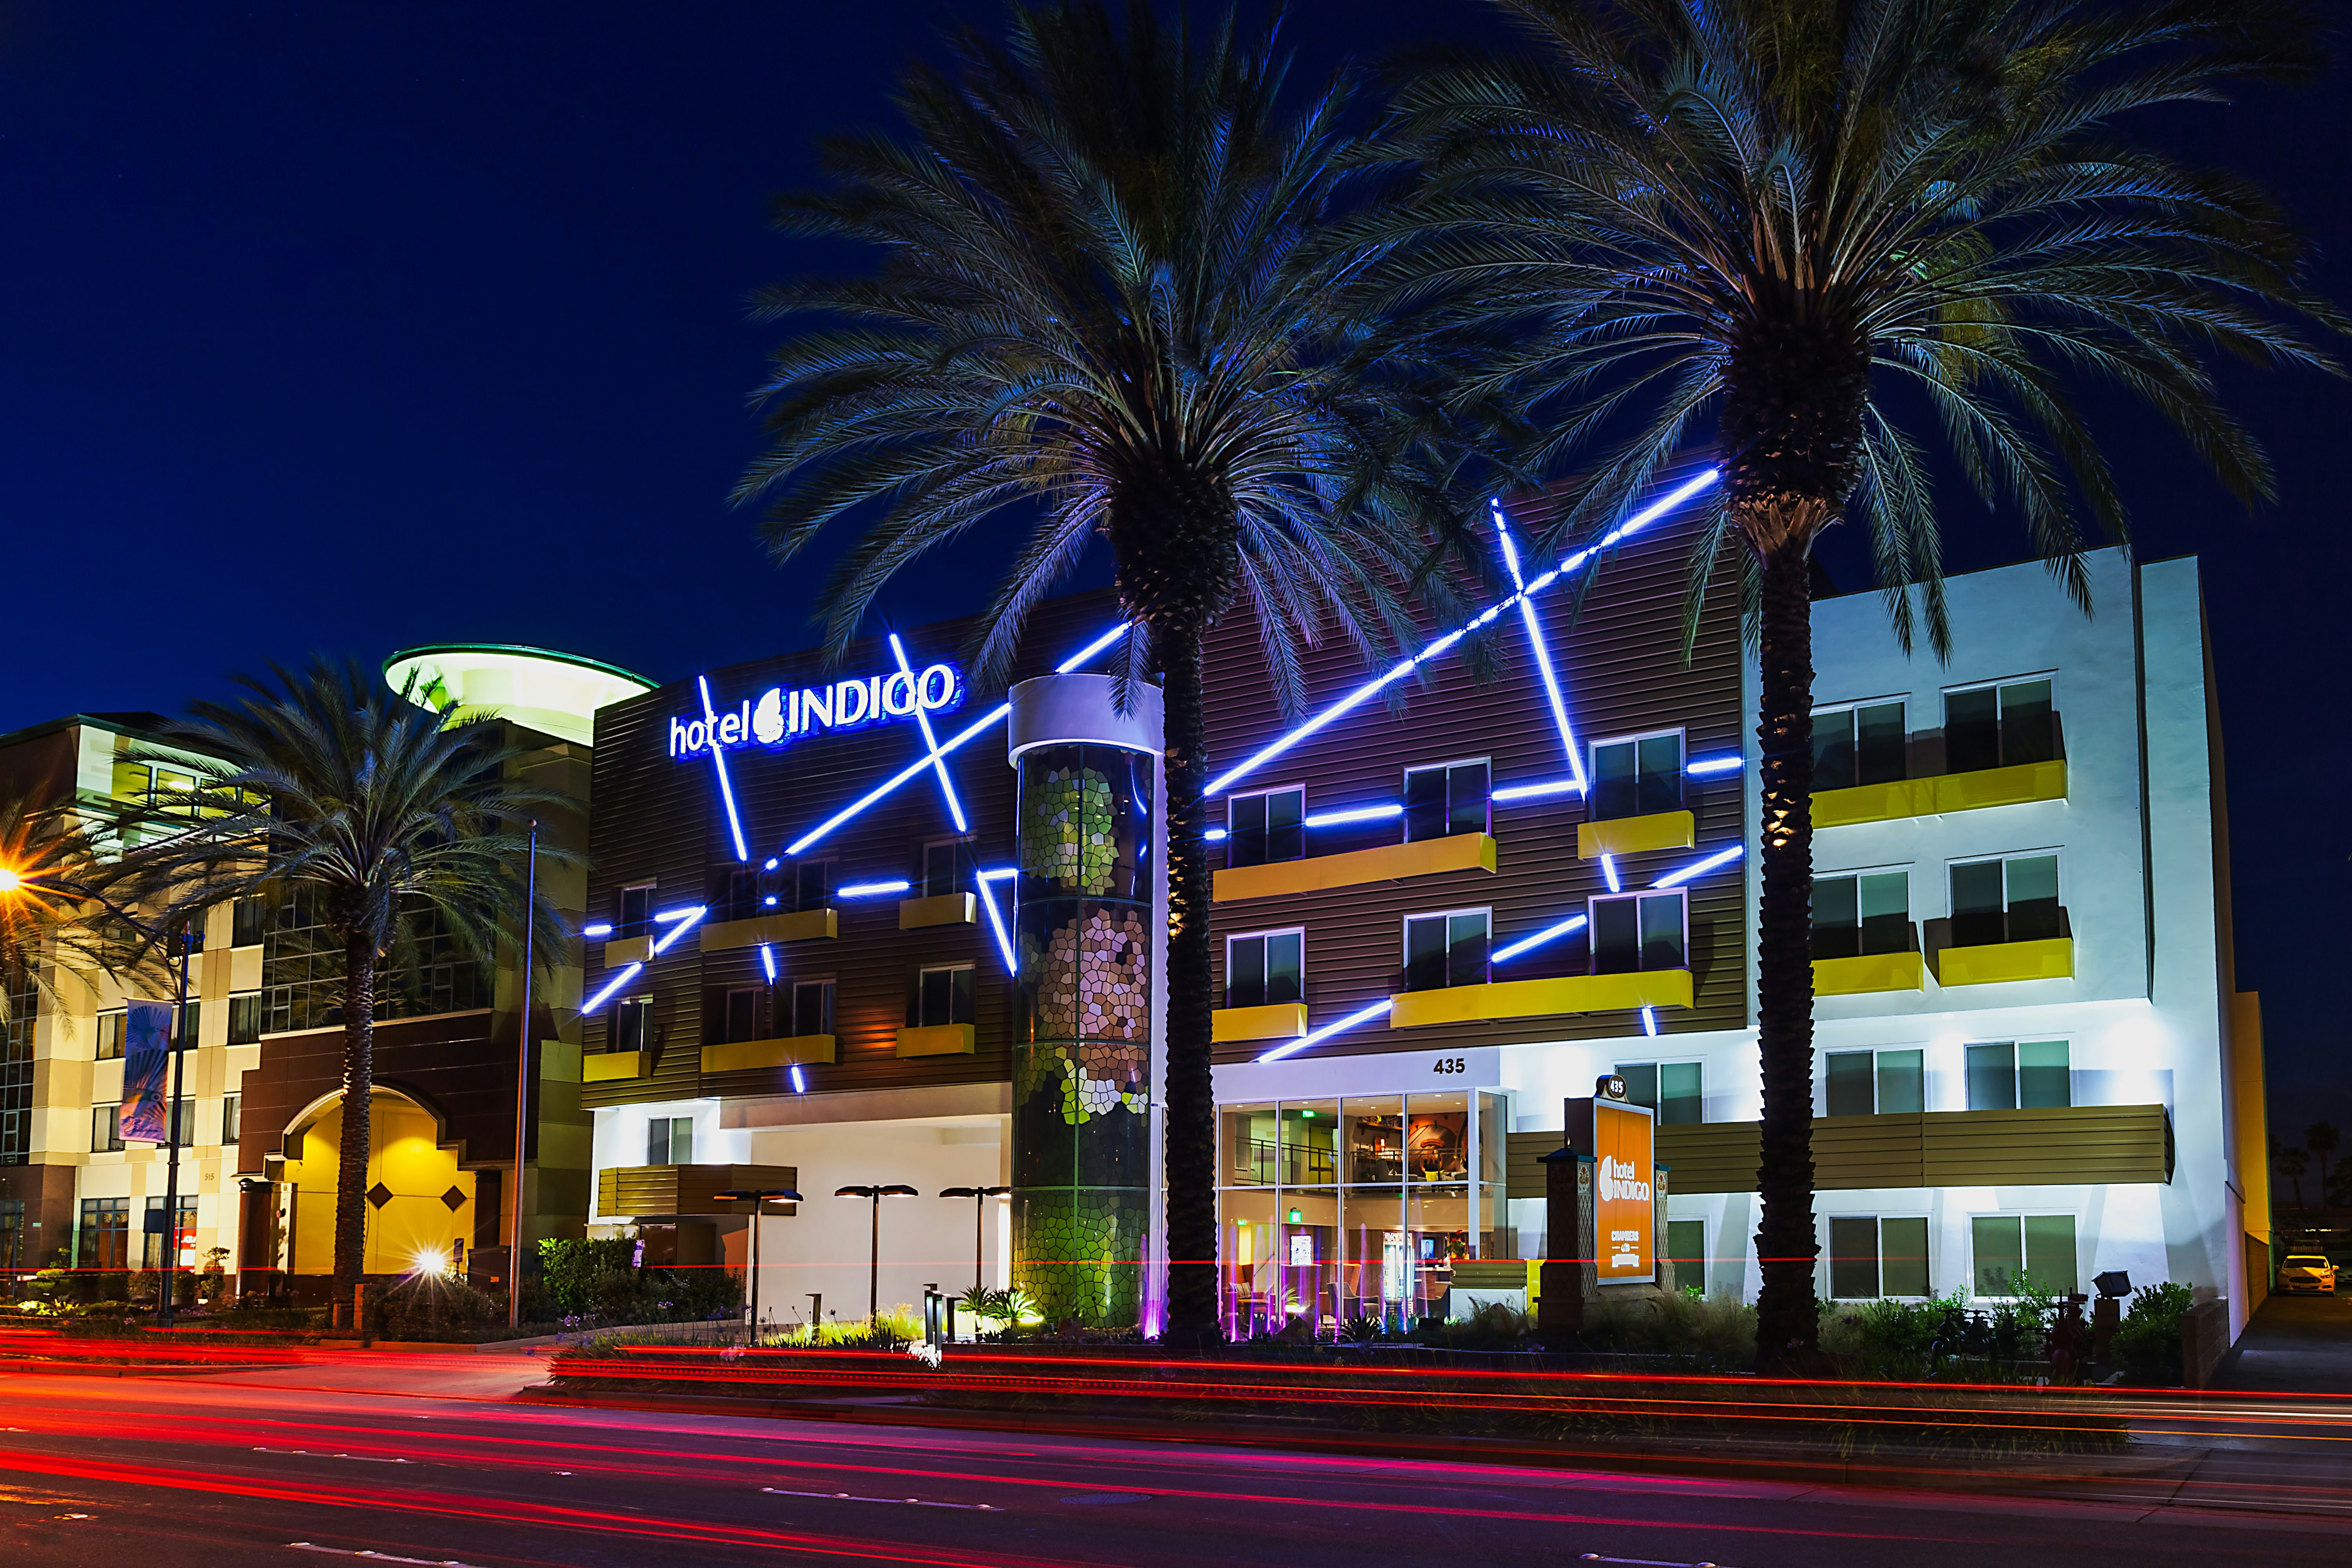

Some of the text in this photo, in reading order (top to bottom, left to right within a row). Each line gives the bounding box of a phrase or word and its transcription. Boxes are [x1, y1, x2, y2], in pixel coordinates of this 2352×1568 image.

[670, 664, 956, 756] hotel INDIGO
[1434, 1058, 1465, 1074] 435
[1610, 1080, 1623, 1093] 435
[1613, 1159, 1635, 1180] hotel
[1613, 1180, 1649, 1201] INDIGO
